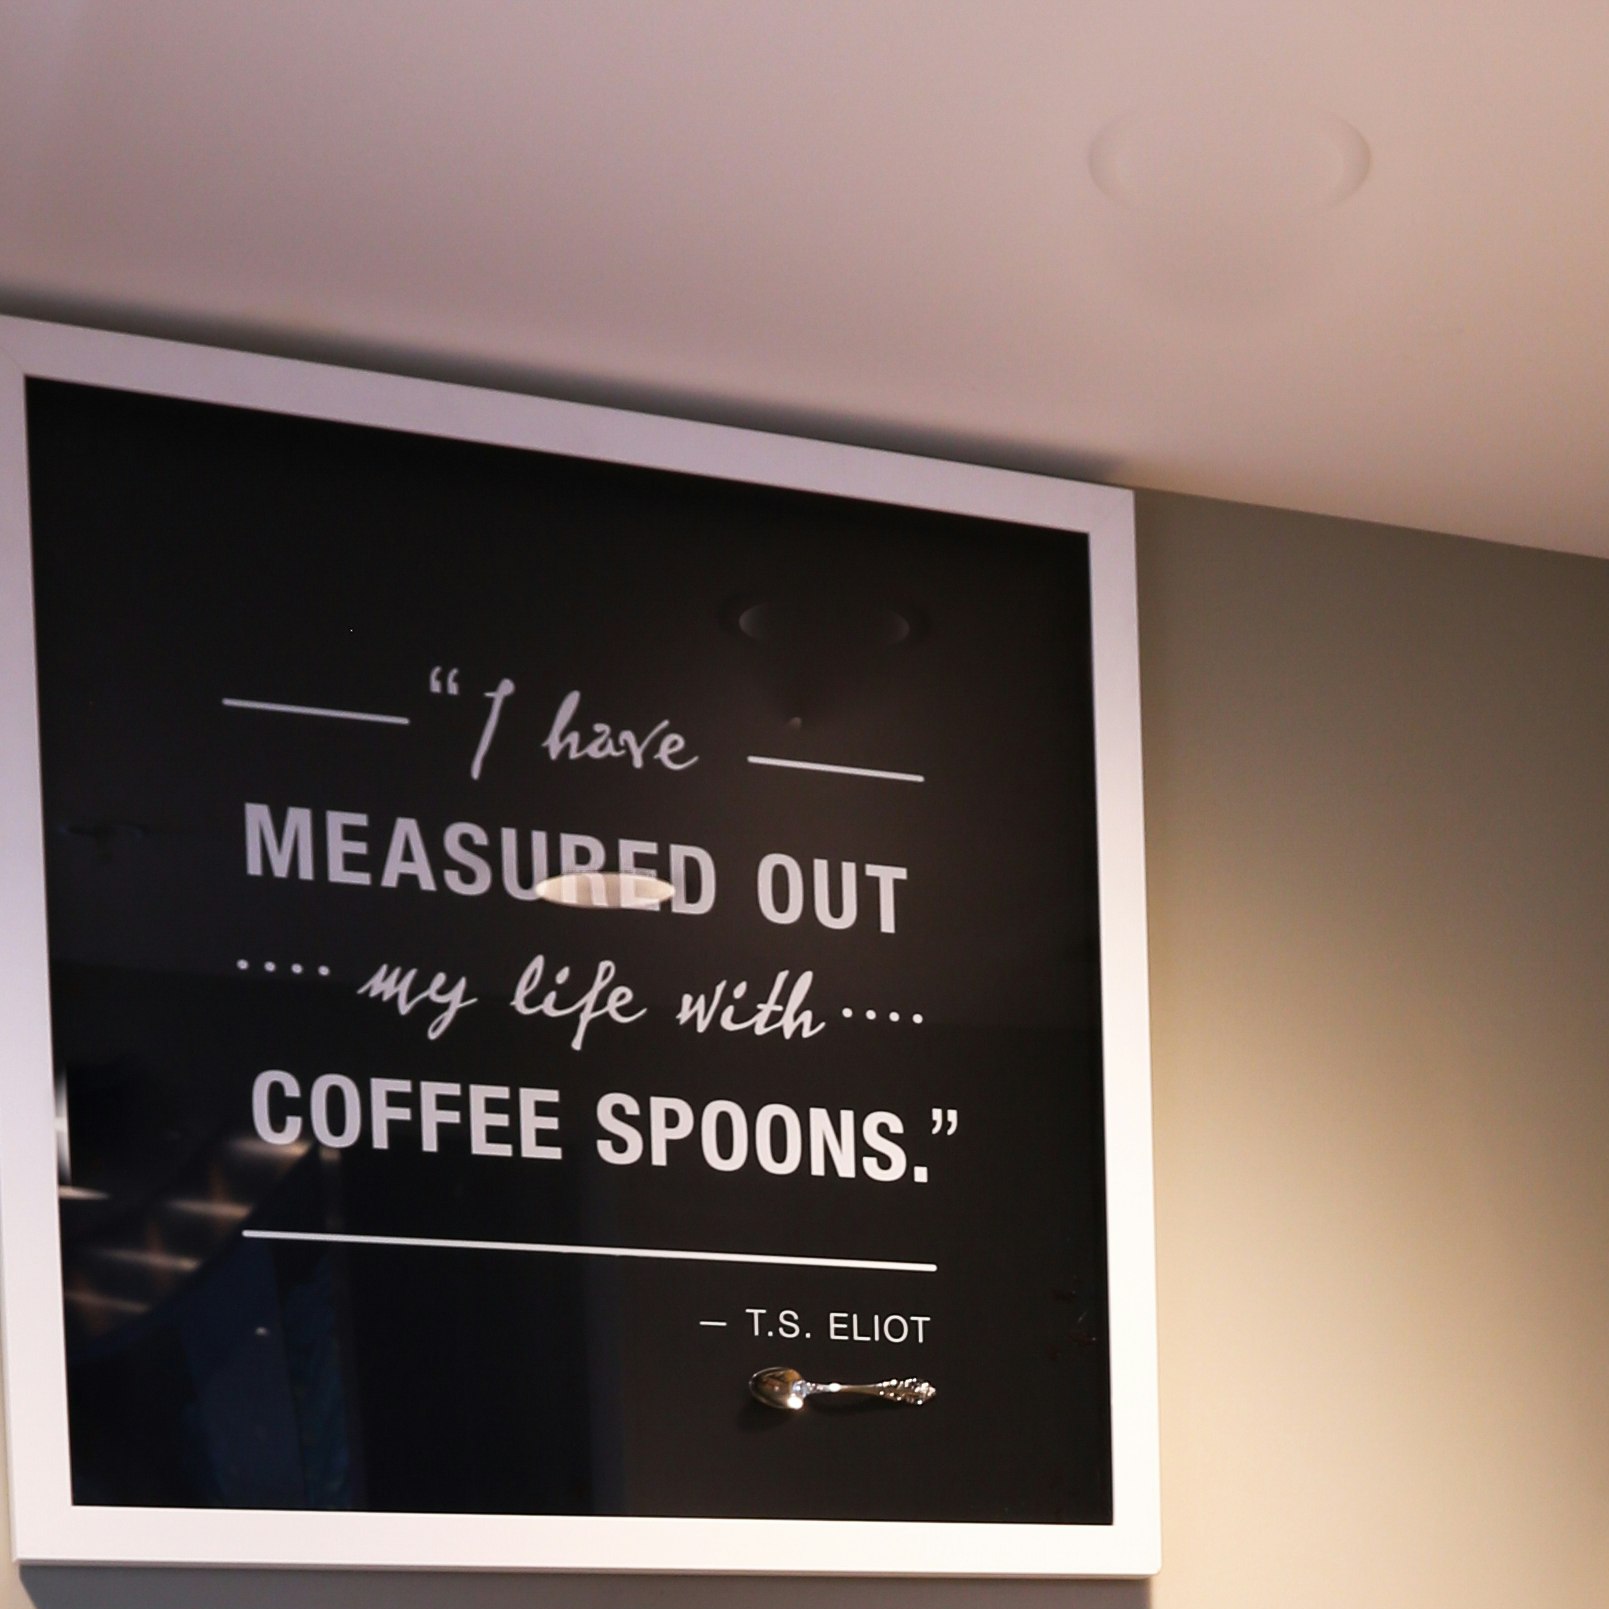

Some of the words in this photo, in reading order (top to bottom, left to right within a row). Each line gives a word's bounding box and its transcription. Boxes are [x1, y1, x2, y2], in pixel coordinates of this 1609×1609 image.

[542, 690, 699, 771] have
[243, 803, 717, 917] MEASURED
[757, 852, 909, 935] OUT
[356, 958, 477, 1041] my
[510, 954, 647, 1050] life
[676, 969, 826, 1041] with
[251, 1068, 564, 1162] COFFEE
[595, 1091, 960, 1184] SPOONS.”
[745, 1307, 813, 1341] T.S.
[828, 1310, 931, 1345] ELIOT
